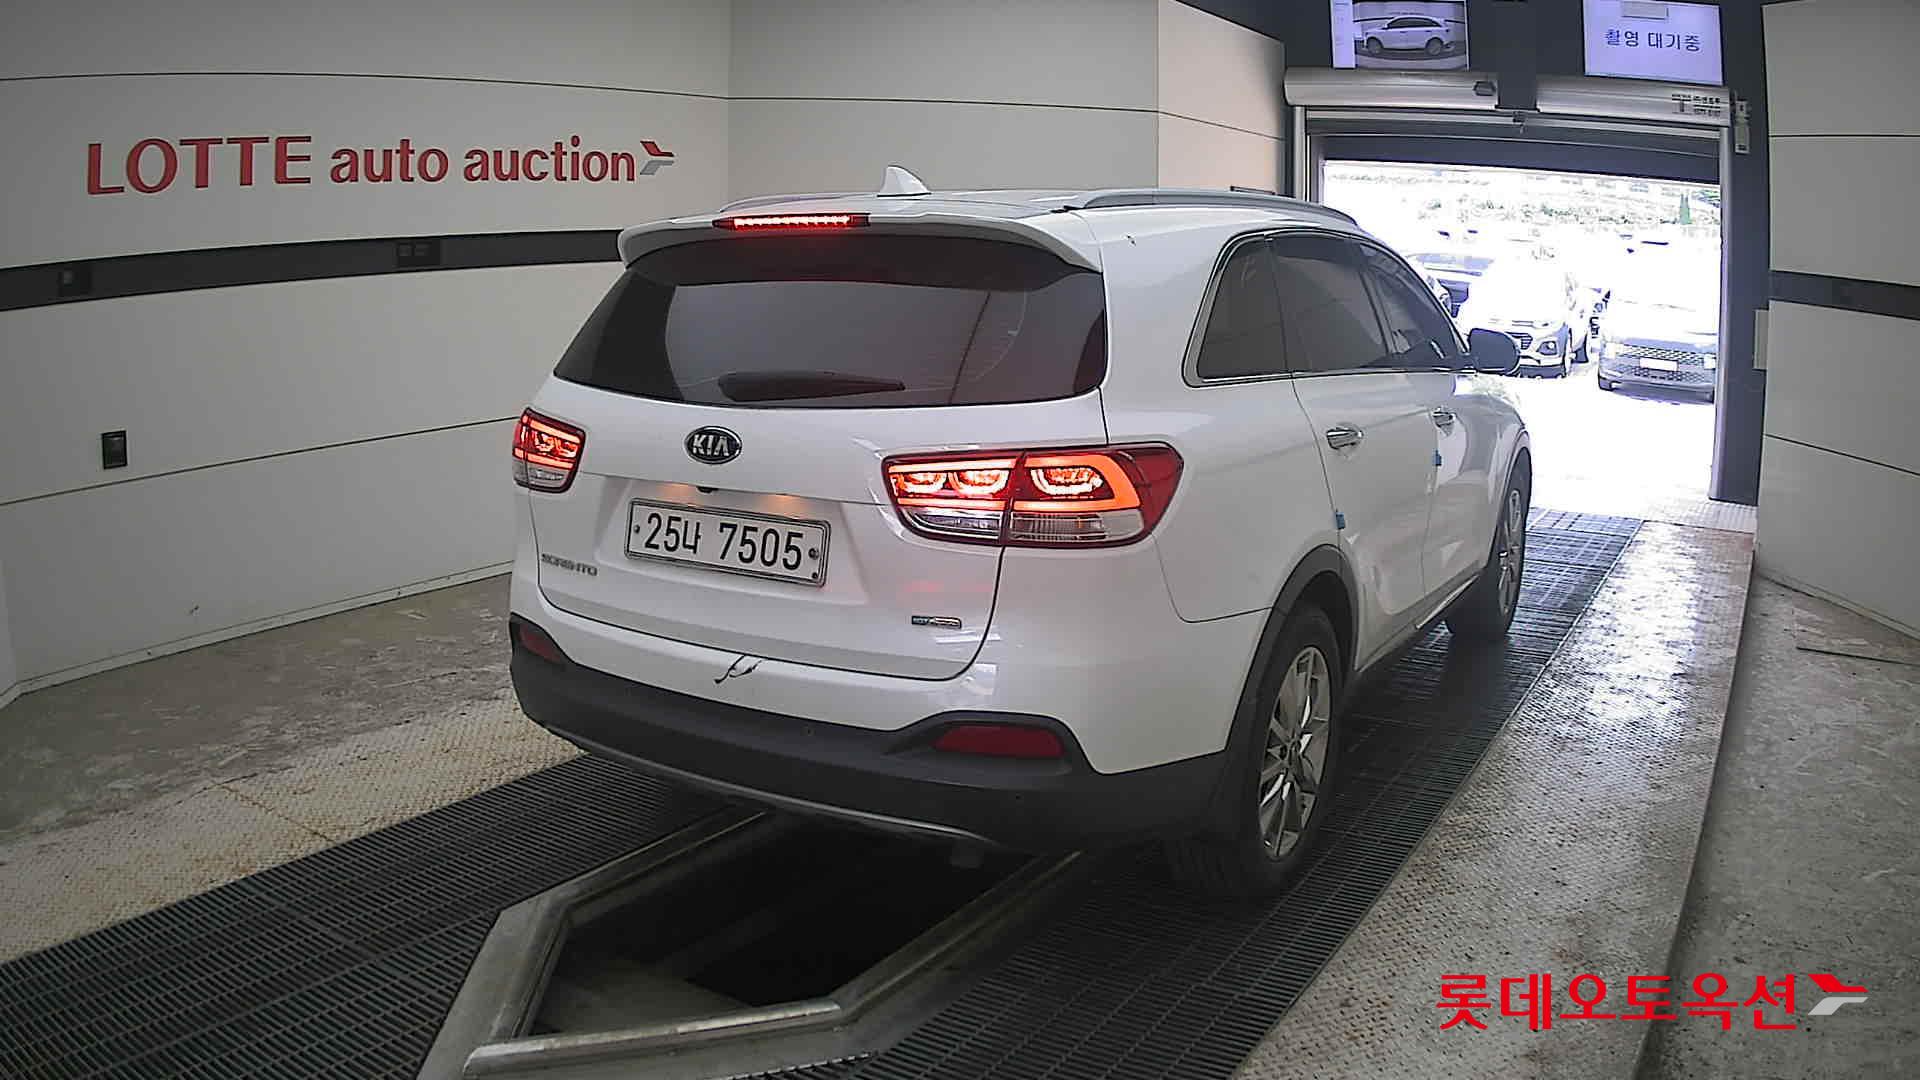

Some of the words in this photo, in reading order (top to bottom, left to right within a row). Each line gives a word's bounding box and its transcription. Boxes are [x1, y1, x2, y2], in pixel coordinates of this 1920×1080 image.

[1647, 32, 1701, 52] 대기중
[87, 135, 312, 195] LOTTE
[329, 138, 449, 184] auto
[463, 135, 636, 183] auction
[692, 434, 730, 456] KIA
[644, 512, 702, 555] 25나
[719, 522, 804, 571] 7505
